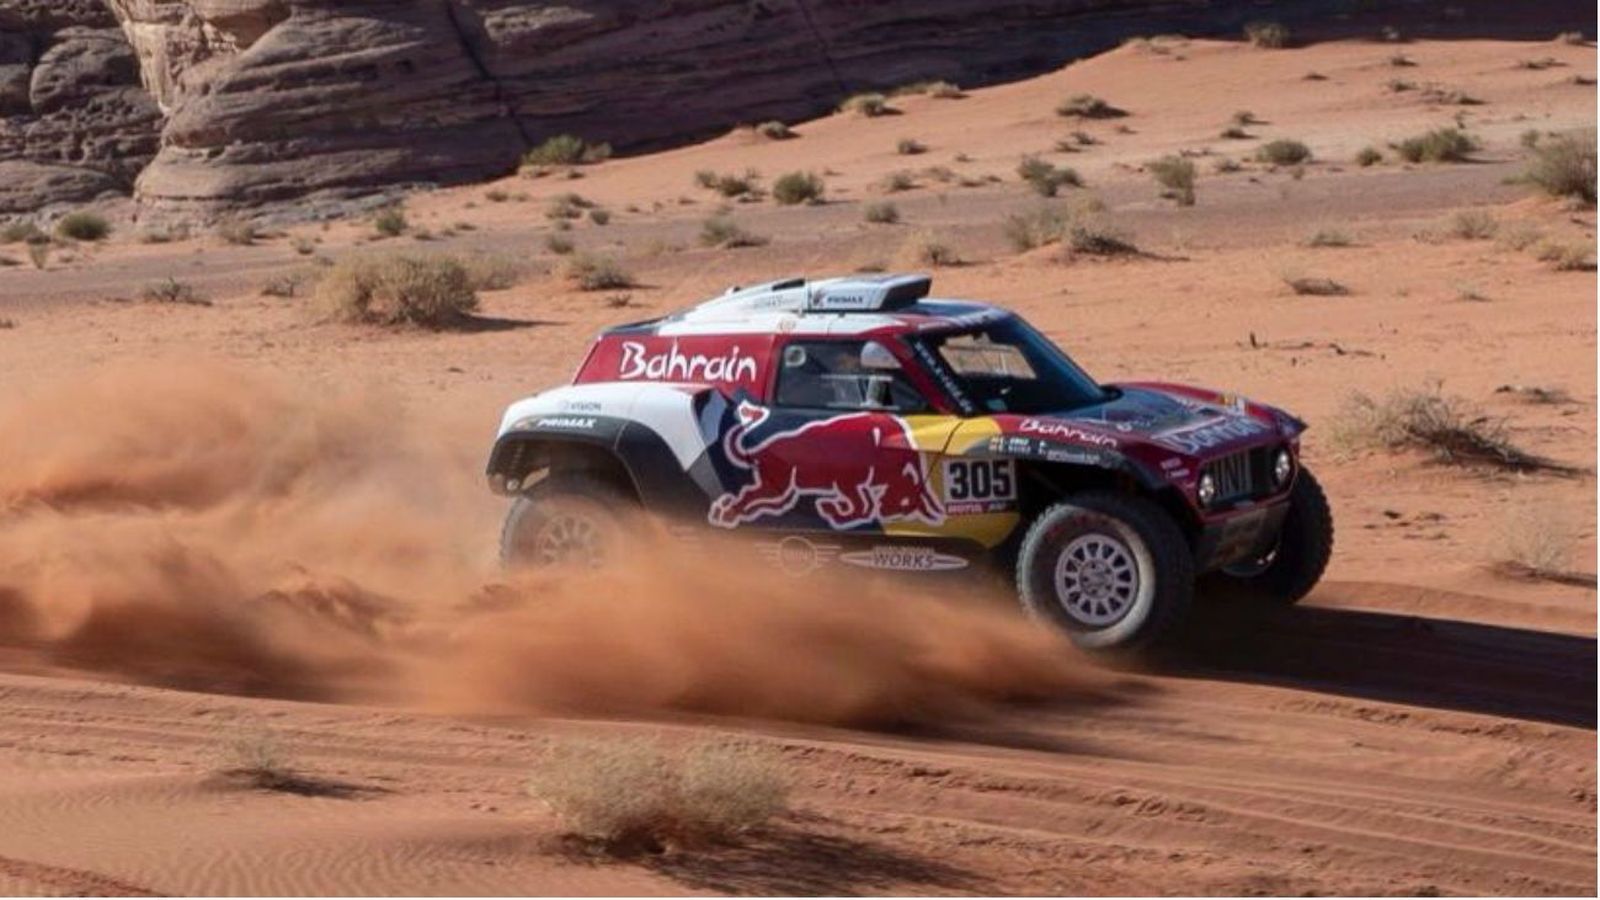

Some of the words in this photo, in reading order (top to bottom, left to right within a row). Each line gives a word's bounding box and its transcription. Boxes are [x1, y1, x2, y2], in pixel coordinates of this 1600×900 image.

[619, 336, 757, 382] Bahrain
[538, 417, 598, 430] PRIMAX
[1019, 417, 1118, 449] Bahrain
[949, 460, 1012, 500] 305
[873, 552, 935, 569] WORKS
